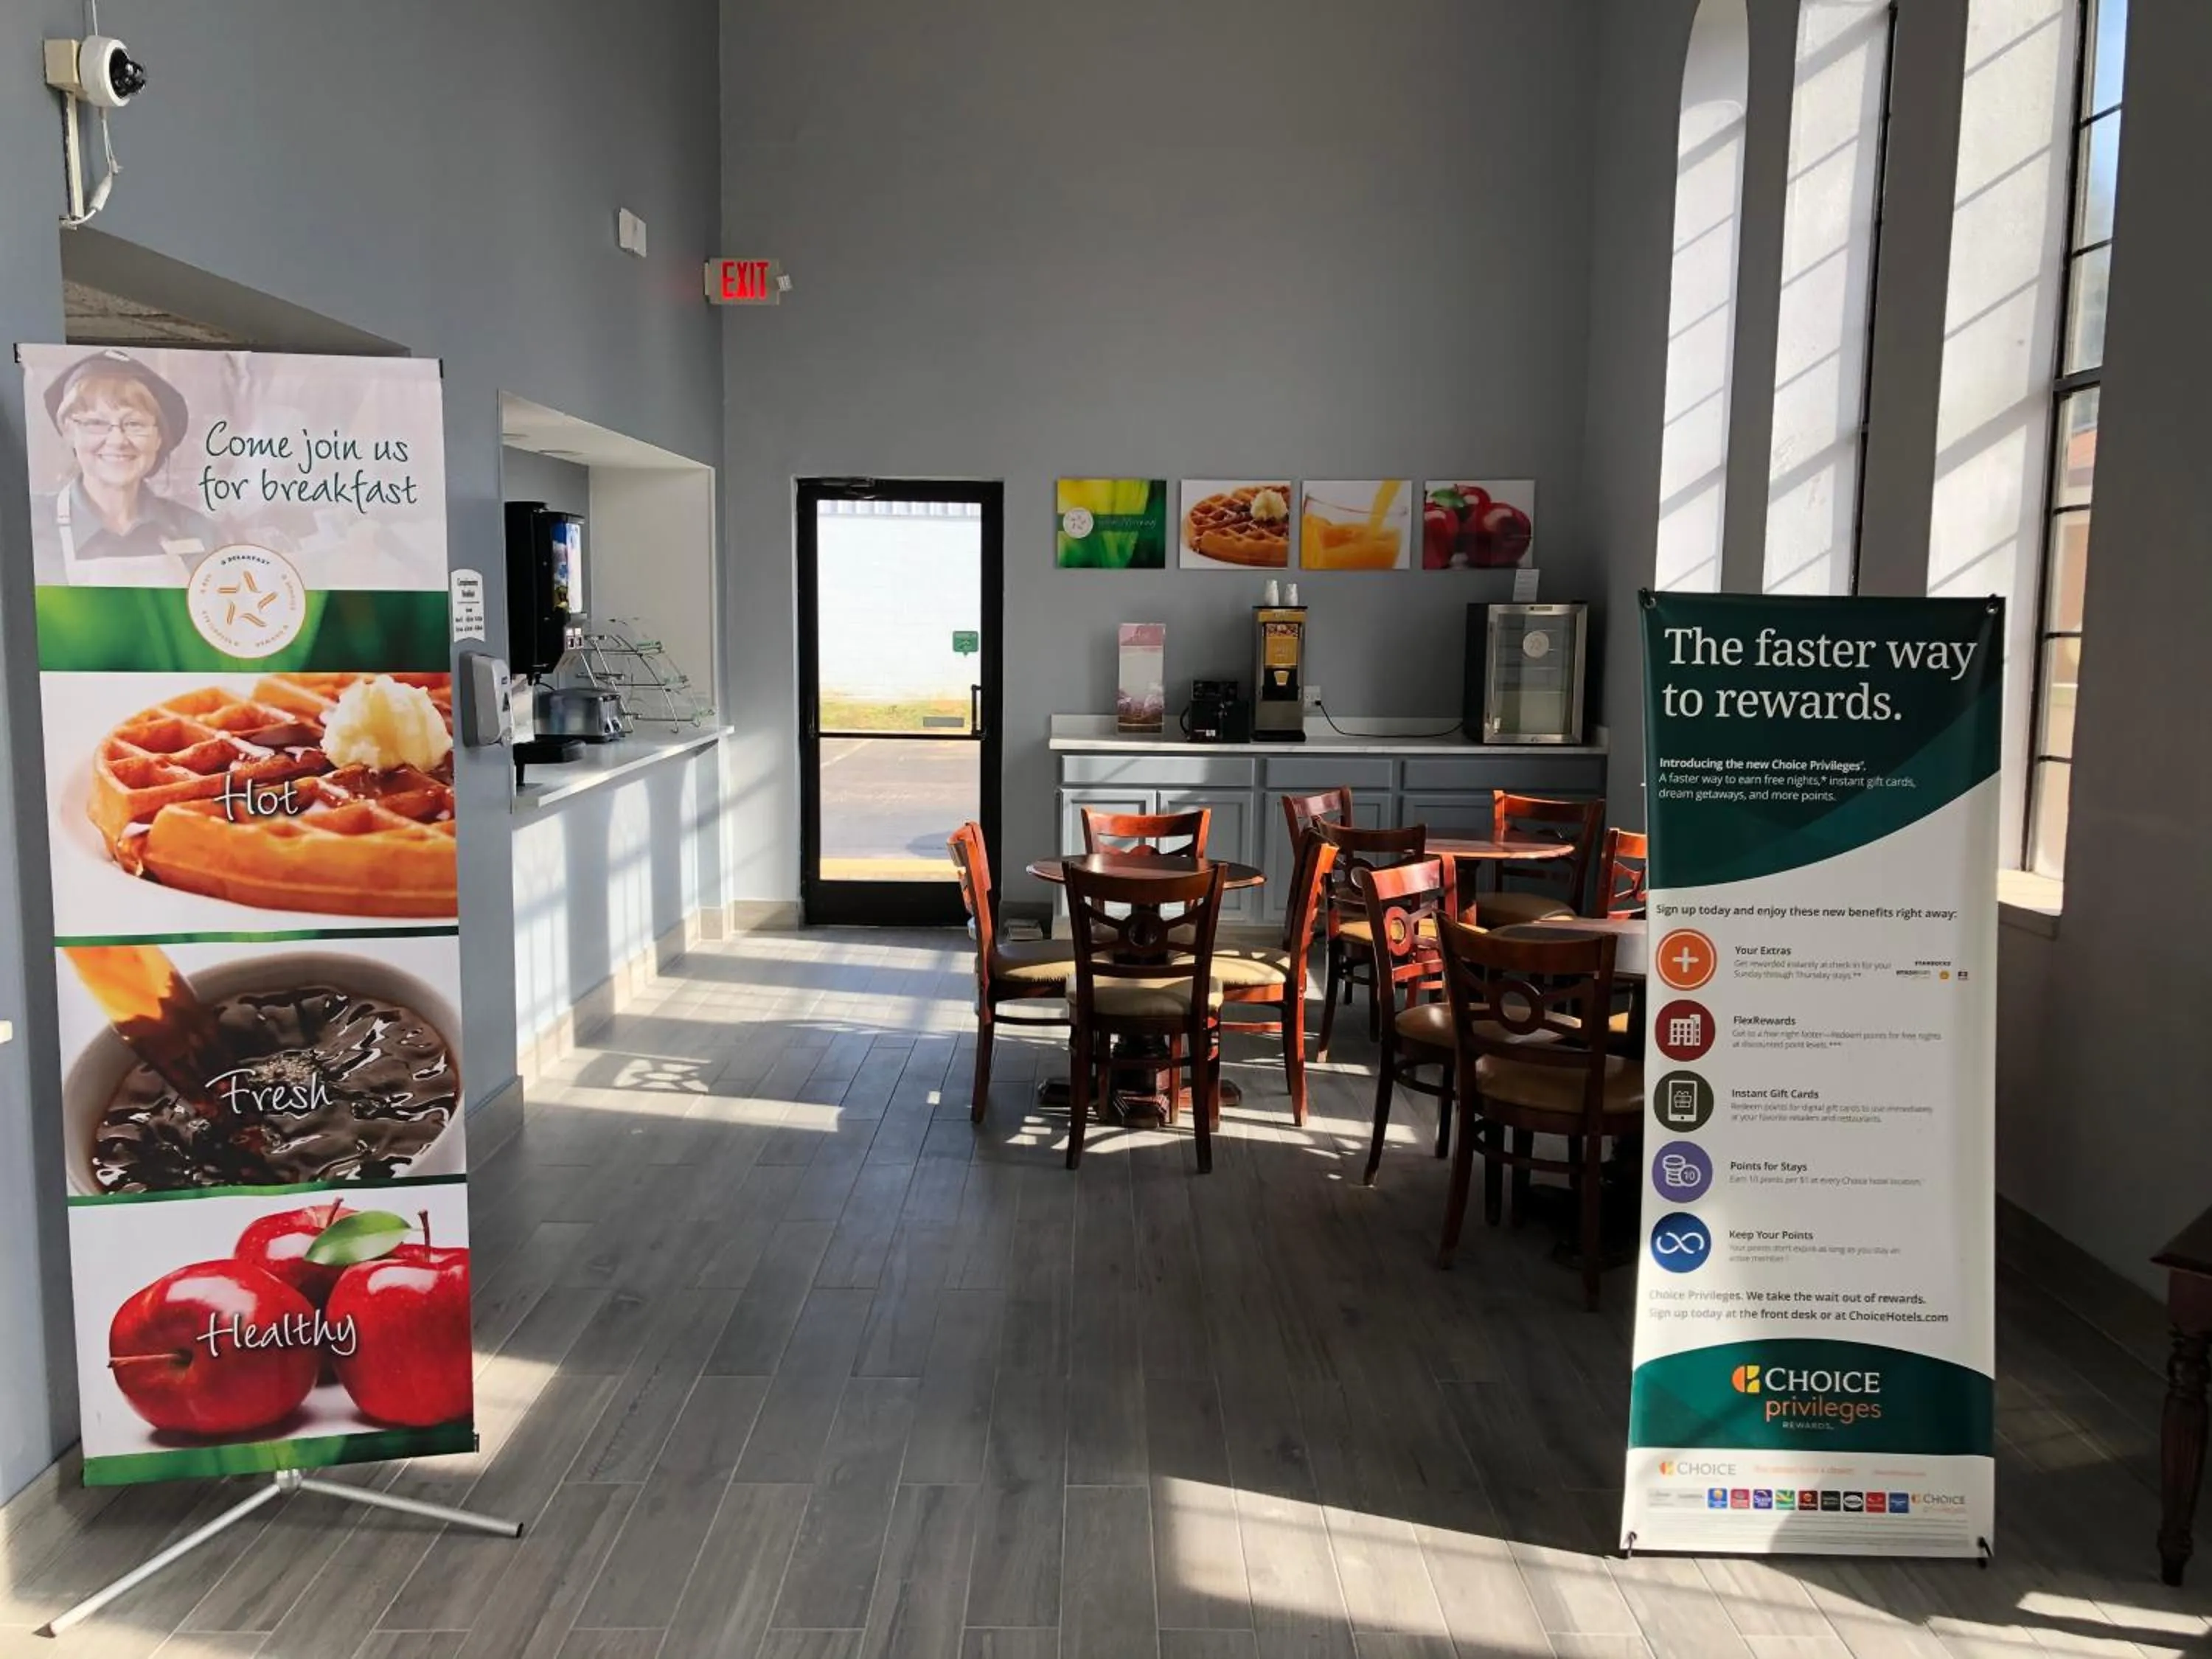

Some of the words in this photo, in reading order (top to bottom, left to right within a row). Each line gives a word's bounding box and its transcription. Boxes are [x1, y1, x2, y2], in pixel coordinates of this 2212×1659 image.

[722, 261, 769, 300] EXIT
[206, 420, 293, 457] Come
[298, 428, 363, 474] join
[375, 440, 408, 462] us
[199, 465, 248, 512] for
[262, 469, 417, 515] breakfast
[1664, 627, 1742, 667] The
[1755, 627, 1877, 668] faster
[1887, 641, 1977, 681] way
[1663, 683, 1703, 717] to
[1715, 683, 1903, 722] rewards.
[1660, 758, 1723, 772] Introducing
[1726, 759, 1743, 769] the
[1746, 761, 1769, 769] new
[1772, 759, 1806, 770] Choice
[1659, 775, 1666, 783] A
[1669, 774, 1699, 784] faster
[1702, 777, 1723, 786] way
[1725, 776, 1735, 784] to
[1764, 775, 1784, 785] free
[1829, 776, 1865, 787] instant
[1867, 776, 1884, 789] gift
[1885, 778, 1916, 788] cards,
[214, 774, 299, 822] Hot
[1659, 789, 1693, 799] dream
[1696, 790, 1746, 802] getaways,
[1749, 790, 1769, 799] and
[1771, 791, 1799, 800] more
[1801, 790, 1836, 802] points.
[1656, 905, 1678, 917] Sign
[1681, 905, 1696, 917] up
[1700, 905, 1731, 918] today
[1733, 905, 1754, 915] and
[1757, 906, 1787, 918] enjoy
[1790, 905, 1819, 917] these
[1822, 908, 1846, 917] new
[1848, 907, 1894, 918] benefits
[1896, 908, 1922, 921] right
[1925, 909, 1958, 921] away:
[1735, 946, 1758, 955] Your
[1760, 946, 1792, 955] Extras
[1733, 1016, 1796, 1026] FlexRewards
[205, 1068, 333, 1115] Fresh
[1732, 1090, 1768, 1098] Instant
[1770, 1089, 1788, 1099] Gift
[1791, 1090, 1819, 1099] Cards
[1731, 1162, 1761, 1172] Points
[1764, 1161, 1778, 1171] for
[1781, 1162, 1807, 1174] Stays
[1729, 1231, 1754, 1241] Keep
[1756, 1231, 1779, 1239] Your
[1782, 1231, 1814, 1240] Points
[1649, 1290, 1684, 1300] Choice
[1688, 1291, 1743, 1303] Privileges.
[1745, 1291, 1764, 1301] We
[1766, 1291, 1791, 1301] take
[1794, 1292, 1812, 1302] the
[1815, 1293, 1840, 1302] wait
[1843, 1293, 1862, 1303] out
[1864, 1293, 1876, 1303] of
[1878, 1293, 1927, 1304] rewards.
[1649, 1308, 1671, 1320] Sign
[1674, 1310, 1688, 1320] up
[1691, 1309, 1722, 1320] today
[1725, 1310, 1736, 1318] at
[1739, 1309, 1758, 1318] the
[1761, 1309, 1789, 1319] front
[1791, 1310, 1817, 1320] desk
[1820, 1312, 1832, 1320] or
[1834, 1311, 1846, 1321] at
[1848, 1310, 1949, 1322] ChoiceHotels.com
[197, 1309, 358, 1357] Healthy
[1764, 1367, 1881, 1393] CHOICE
[1766, 1395, 1882, 1424] privileges
[1677, 1461, 1736, 1475] CHOICE
[1923, 1493, 1966, 1505] CHOICE
